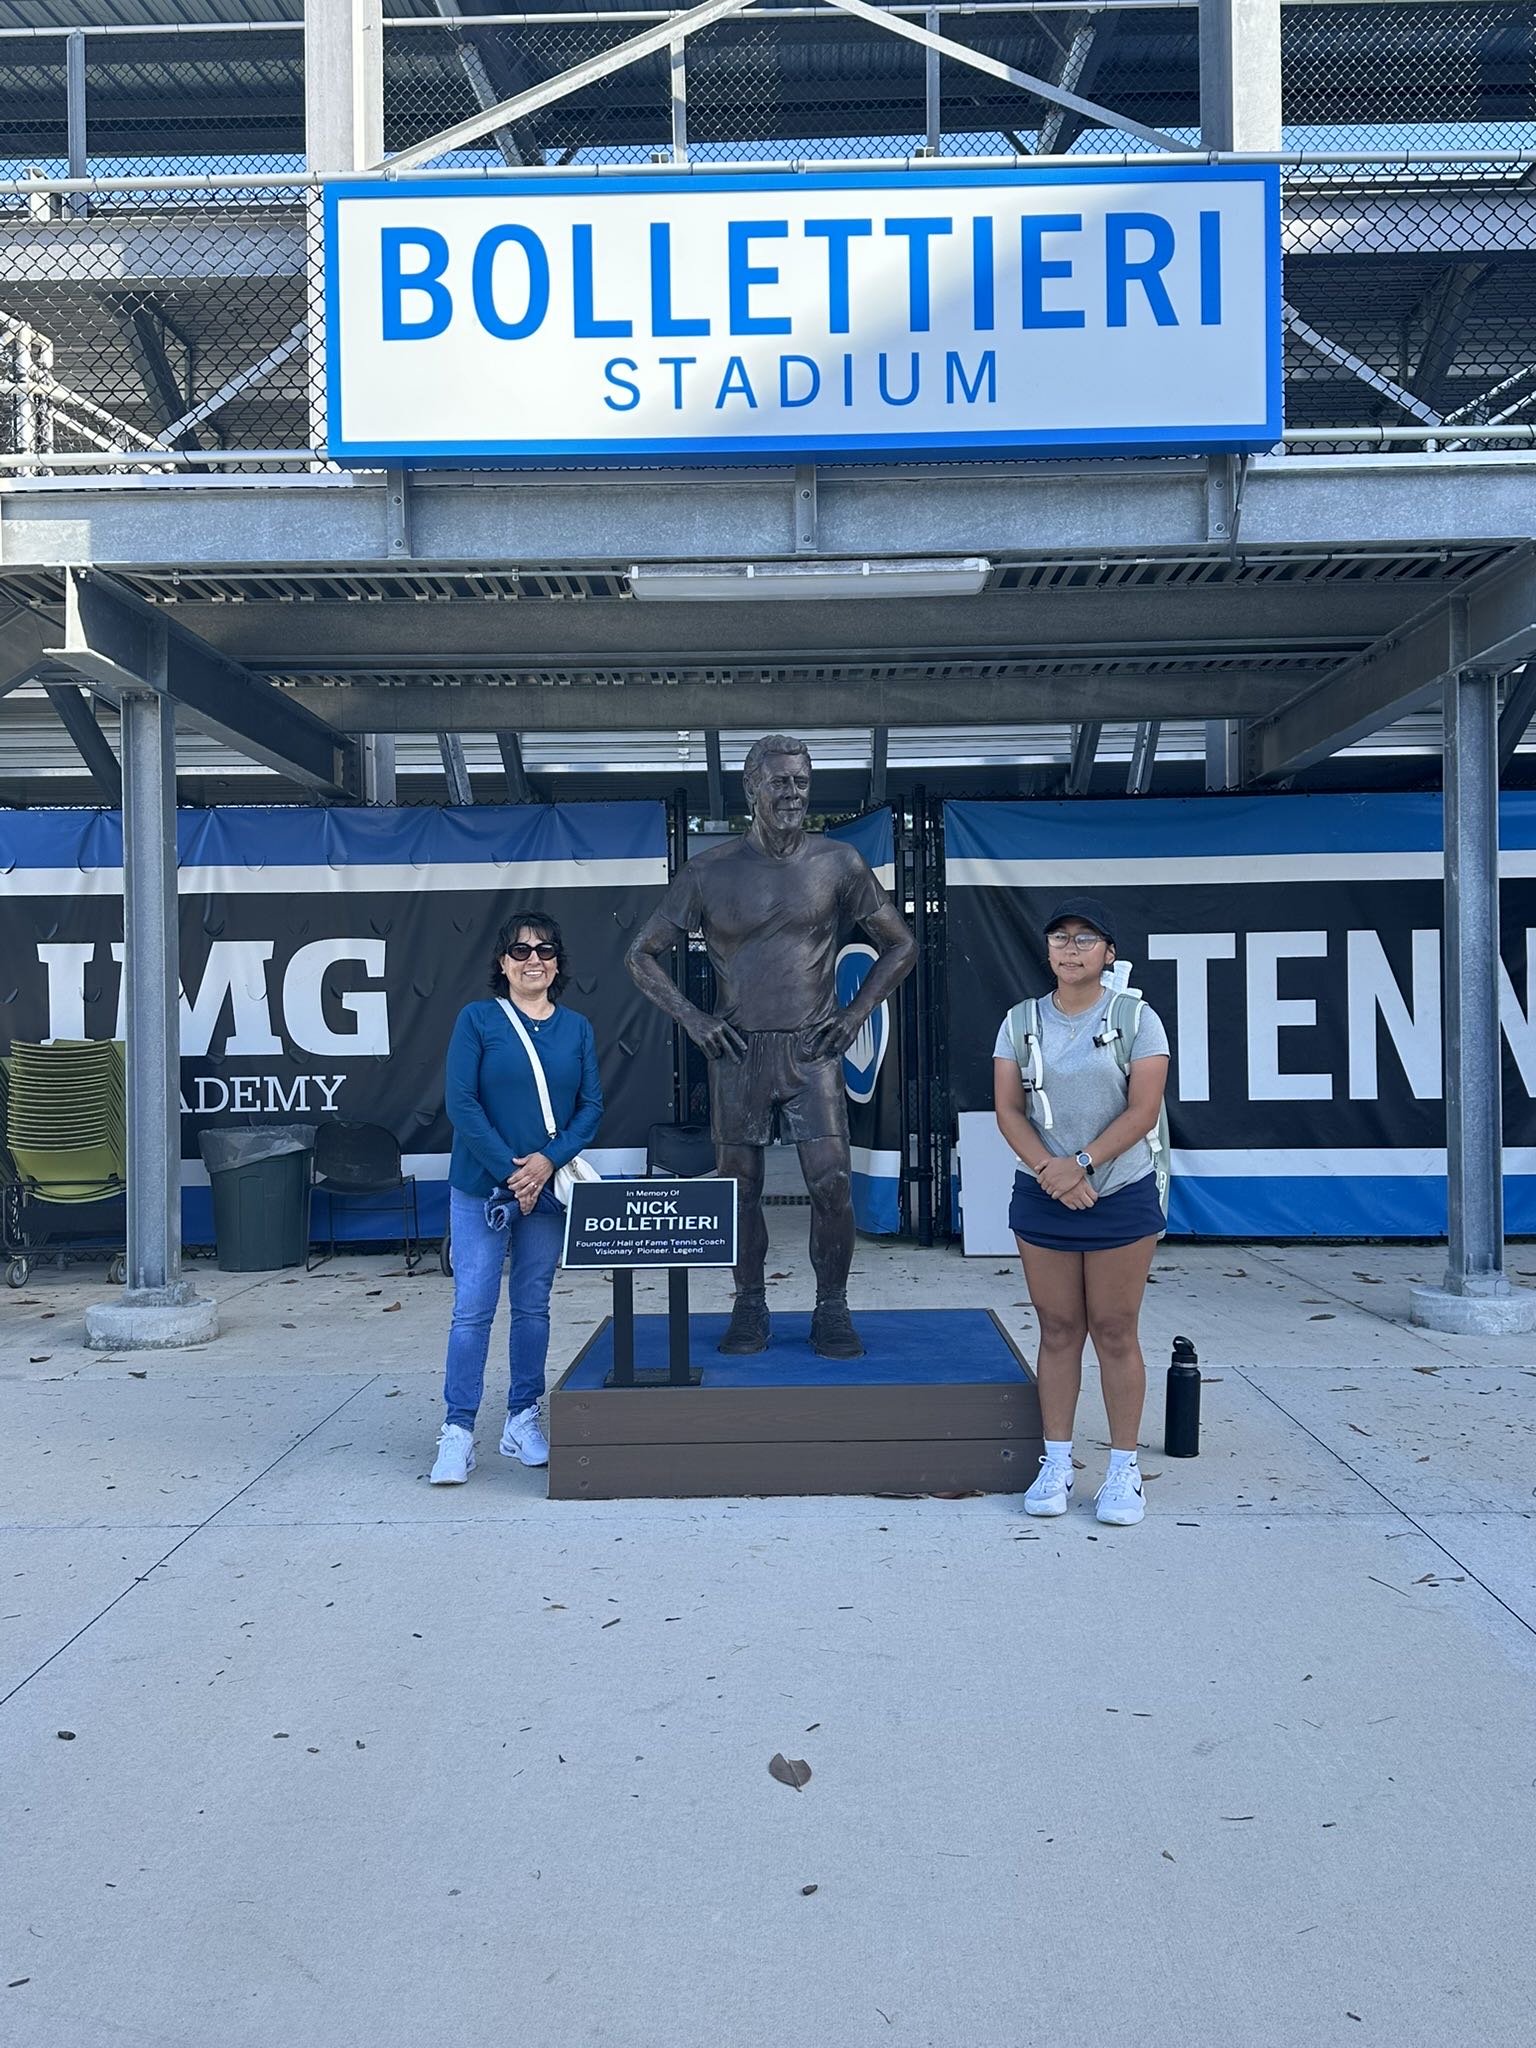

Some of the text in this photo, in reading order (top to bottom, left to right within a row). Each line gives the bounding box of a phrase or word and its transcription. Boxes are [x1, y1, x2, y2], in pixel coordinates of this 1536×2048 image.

[381, 210, 1222, 341] BOLLETTIERI
[604, 349, 997, 412] STADIUM
[37, 938, 391, 1056] IMG
[1145, 929, 1536, 1101] TEN
[636, 1190, 669, 1198] Memory
[670, 1189, 680, 1197] Of
[626, 1200, 679, 1215] NICK
[584, 1216, 719, 1232] BOLLETTIERI
[575, 1240, 610, 1248] Founder
[634, 1239, 644, 1247] of
[645, 1239, 668, 1247] Fame
[670, 1238, 698, 1246] Tennis
[699, 1238, 726, 1246] Coach
[637, 1247, 671, 1255] Pioneer.
